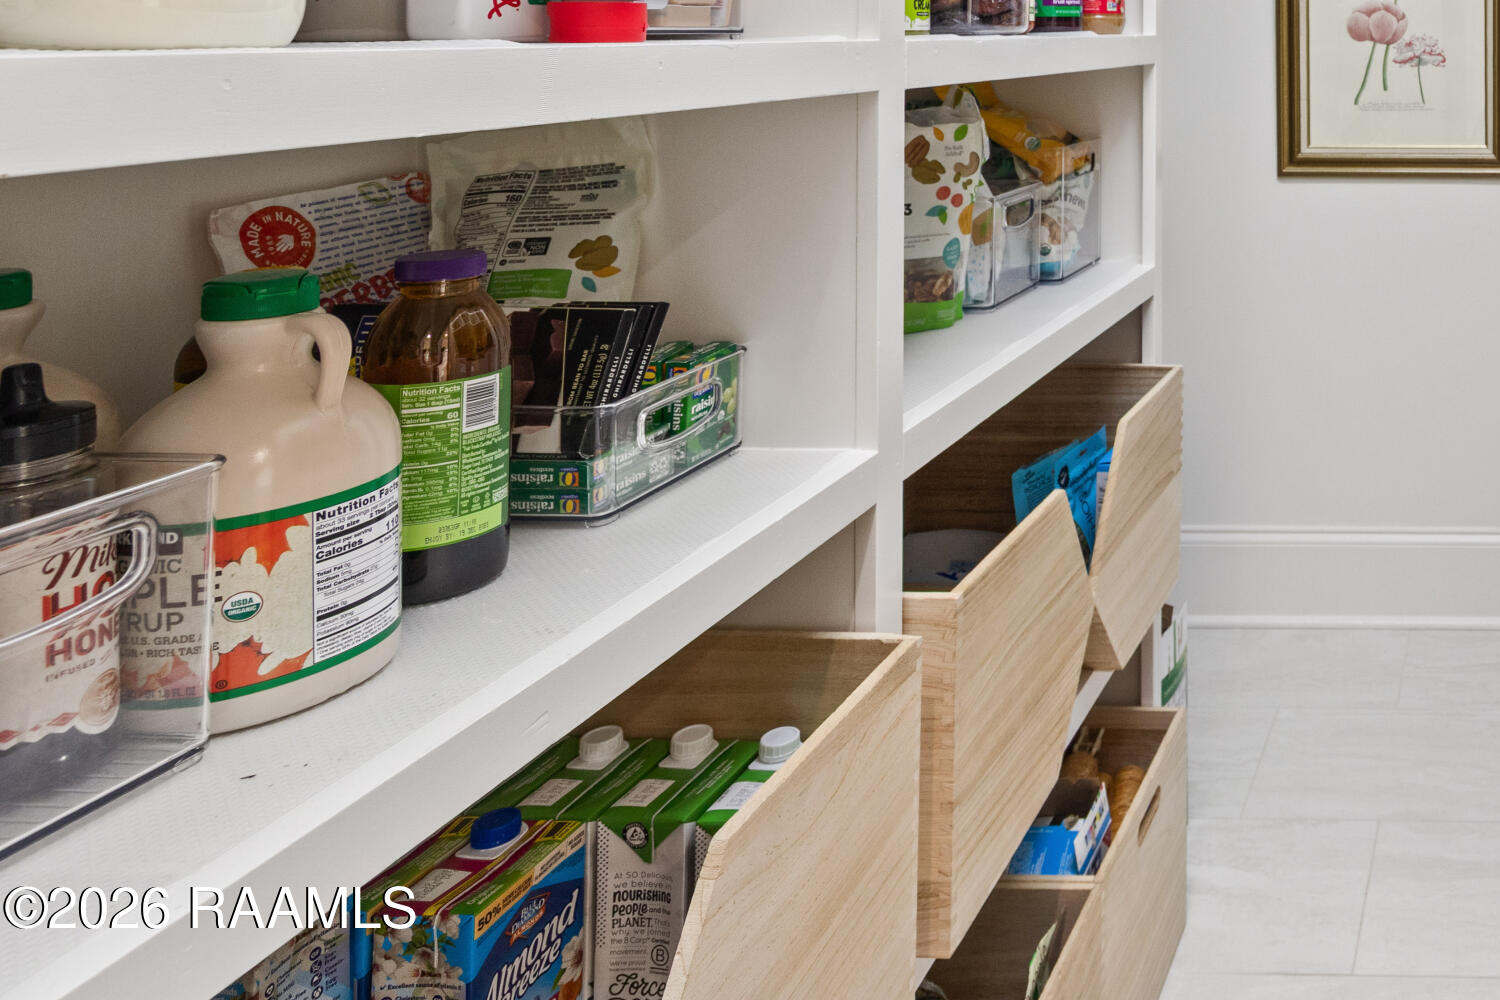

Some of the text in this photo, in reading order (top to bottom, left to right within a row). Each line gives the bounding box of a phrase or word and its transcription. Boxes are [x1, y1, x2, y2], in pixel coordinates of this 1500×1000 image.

[510, 172, 532, 180] Facts
[246, 211, 312, 258] MADE IN NATURE
[612, 348, 634, 398] GHIRARDELLI
[632, 344, 652, 393] GHIRARDELLI
[571, 374, 582, 393] BEAN
[577, 362, 585, 374] TO
[600, 356, 620, 406] GHIRARDELLI
[402, 385, 460, 396] Nutrition Facts
[447, 411, 458, 420] 60
[510, 473, 554, 485] raisins
[316, 481, 399, 522] Nutrition Facts
[511, 501, 554, 512] raisins
[315, 519, 360, 538] Serving size
[316, 520, 336, 530] about
[316, 514, 399, 560] Calories 110
[316, 527, 373, 550] Amount per serving
[316, 568, 332, 577] Total
[333, 564, 344, 572] Fat
[316, 574, 340, 585] Sodium
[316, 568, 370, 592] Total Carbohydrate
[122, 570, 223, 610] PLE
[230, 597, 254, 608] USDA
[316, 603, 340, 615] Protein
[227, 605, 257, 616] ORGANIC
[122, 612, 184, 634] RUP
[46, 616, 120, 668] HONE
[154, 634, 196, 646] GRADE
[146, 641, 220, 658] RICH TASE
[614, 872, 623, 880] At
[630, 880, 664, 888] believe
[477, 904, 502, 932] 50%
[662, 908, 672, 916] the
[610, 929, 630, 939] why
[646, 928, 671, 938] joined
[610, 936, 623, 945] the
[486, 888, 580, 1000] Almond
[656, 949, 665, 962] B
[501, 937, 562, 1000] reeze
[608, 972, 667, 997] Force
